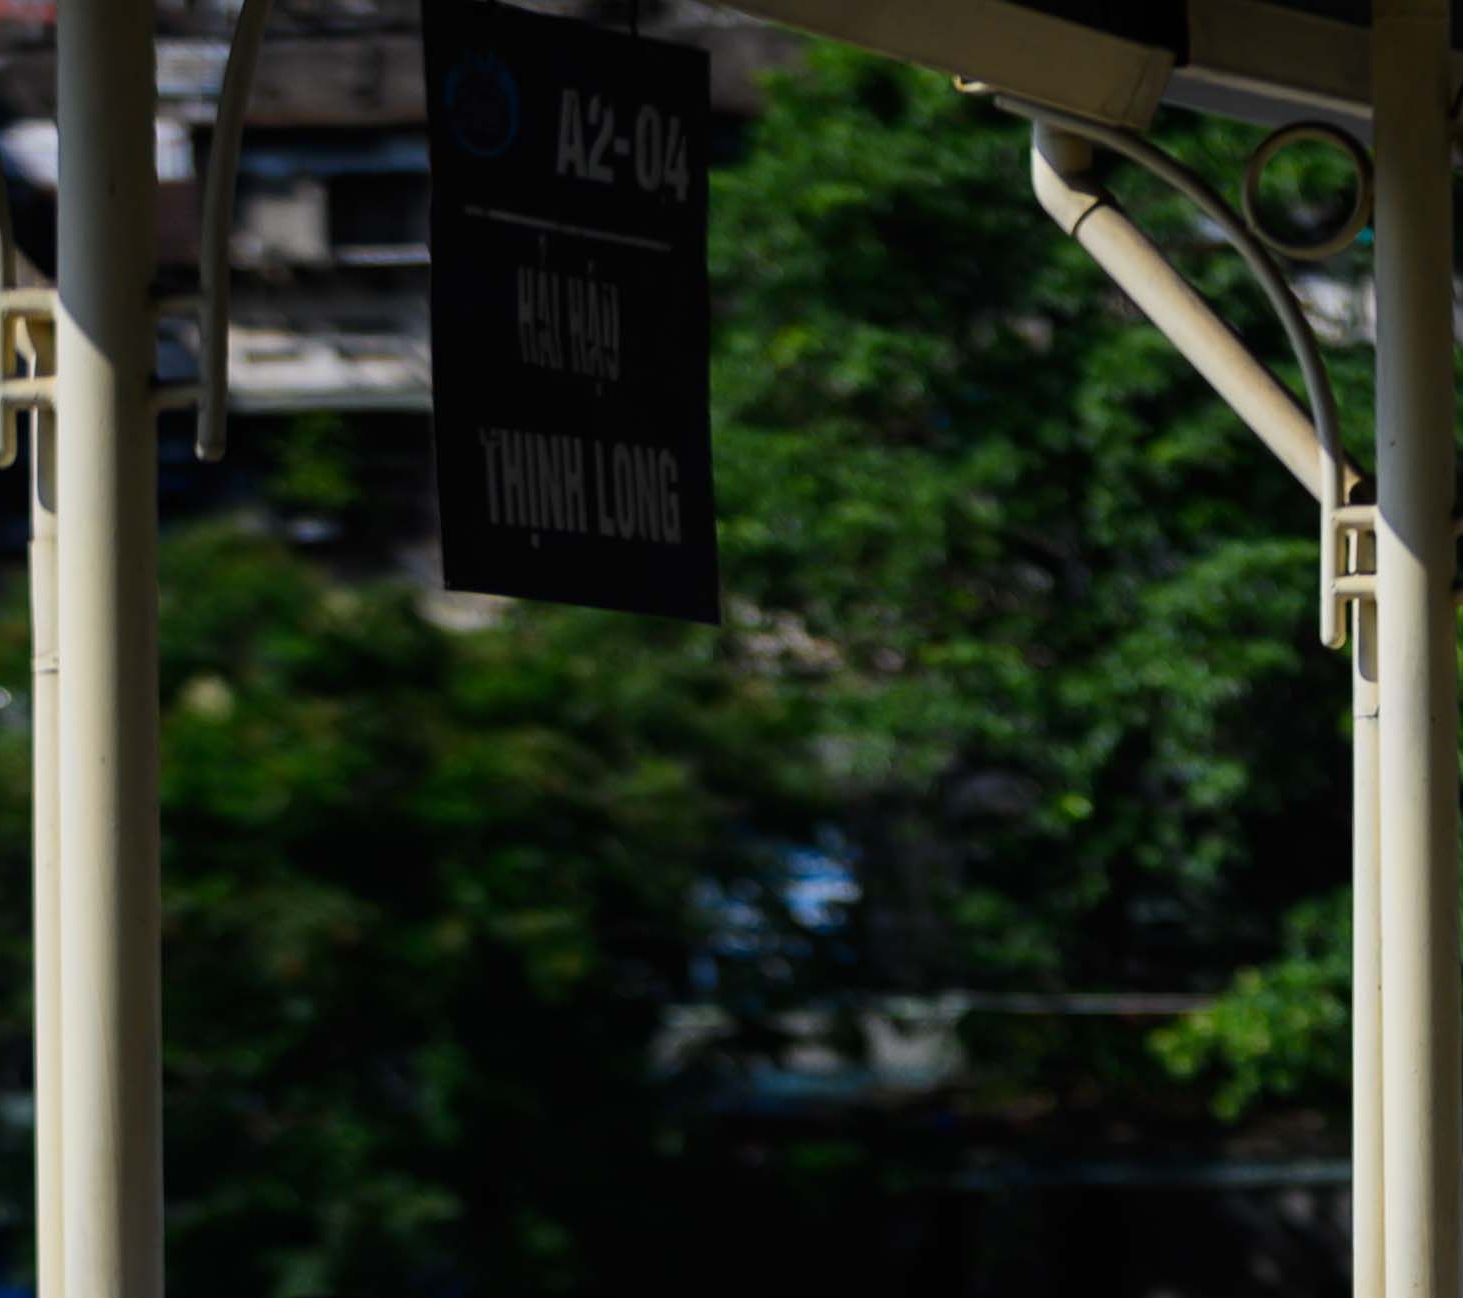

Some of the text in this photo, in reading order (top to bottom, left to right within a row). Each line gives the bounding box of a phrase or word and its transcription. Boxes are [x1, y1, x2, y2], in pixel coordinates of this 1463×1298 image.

[554, 87, 693, 204] A2-04
[478, 426, 684, 549] THỊNH LONG
